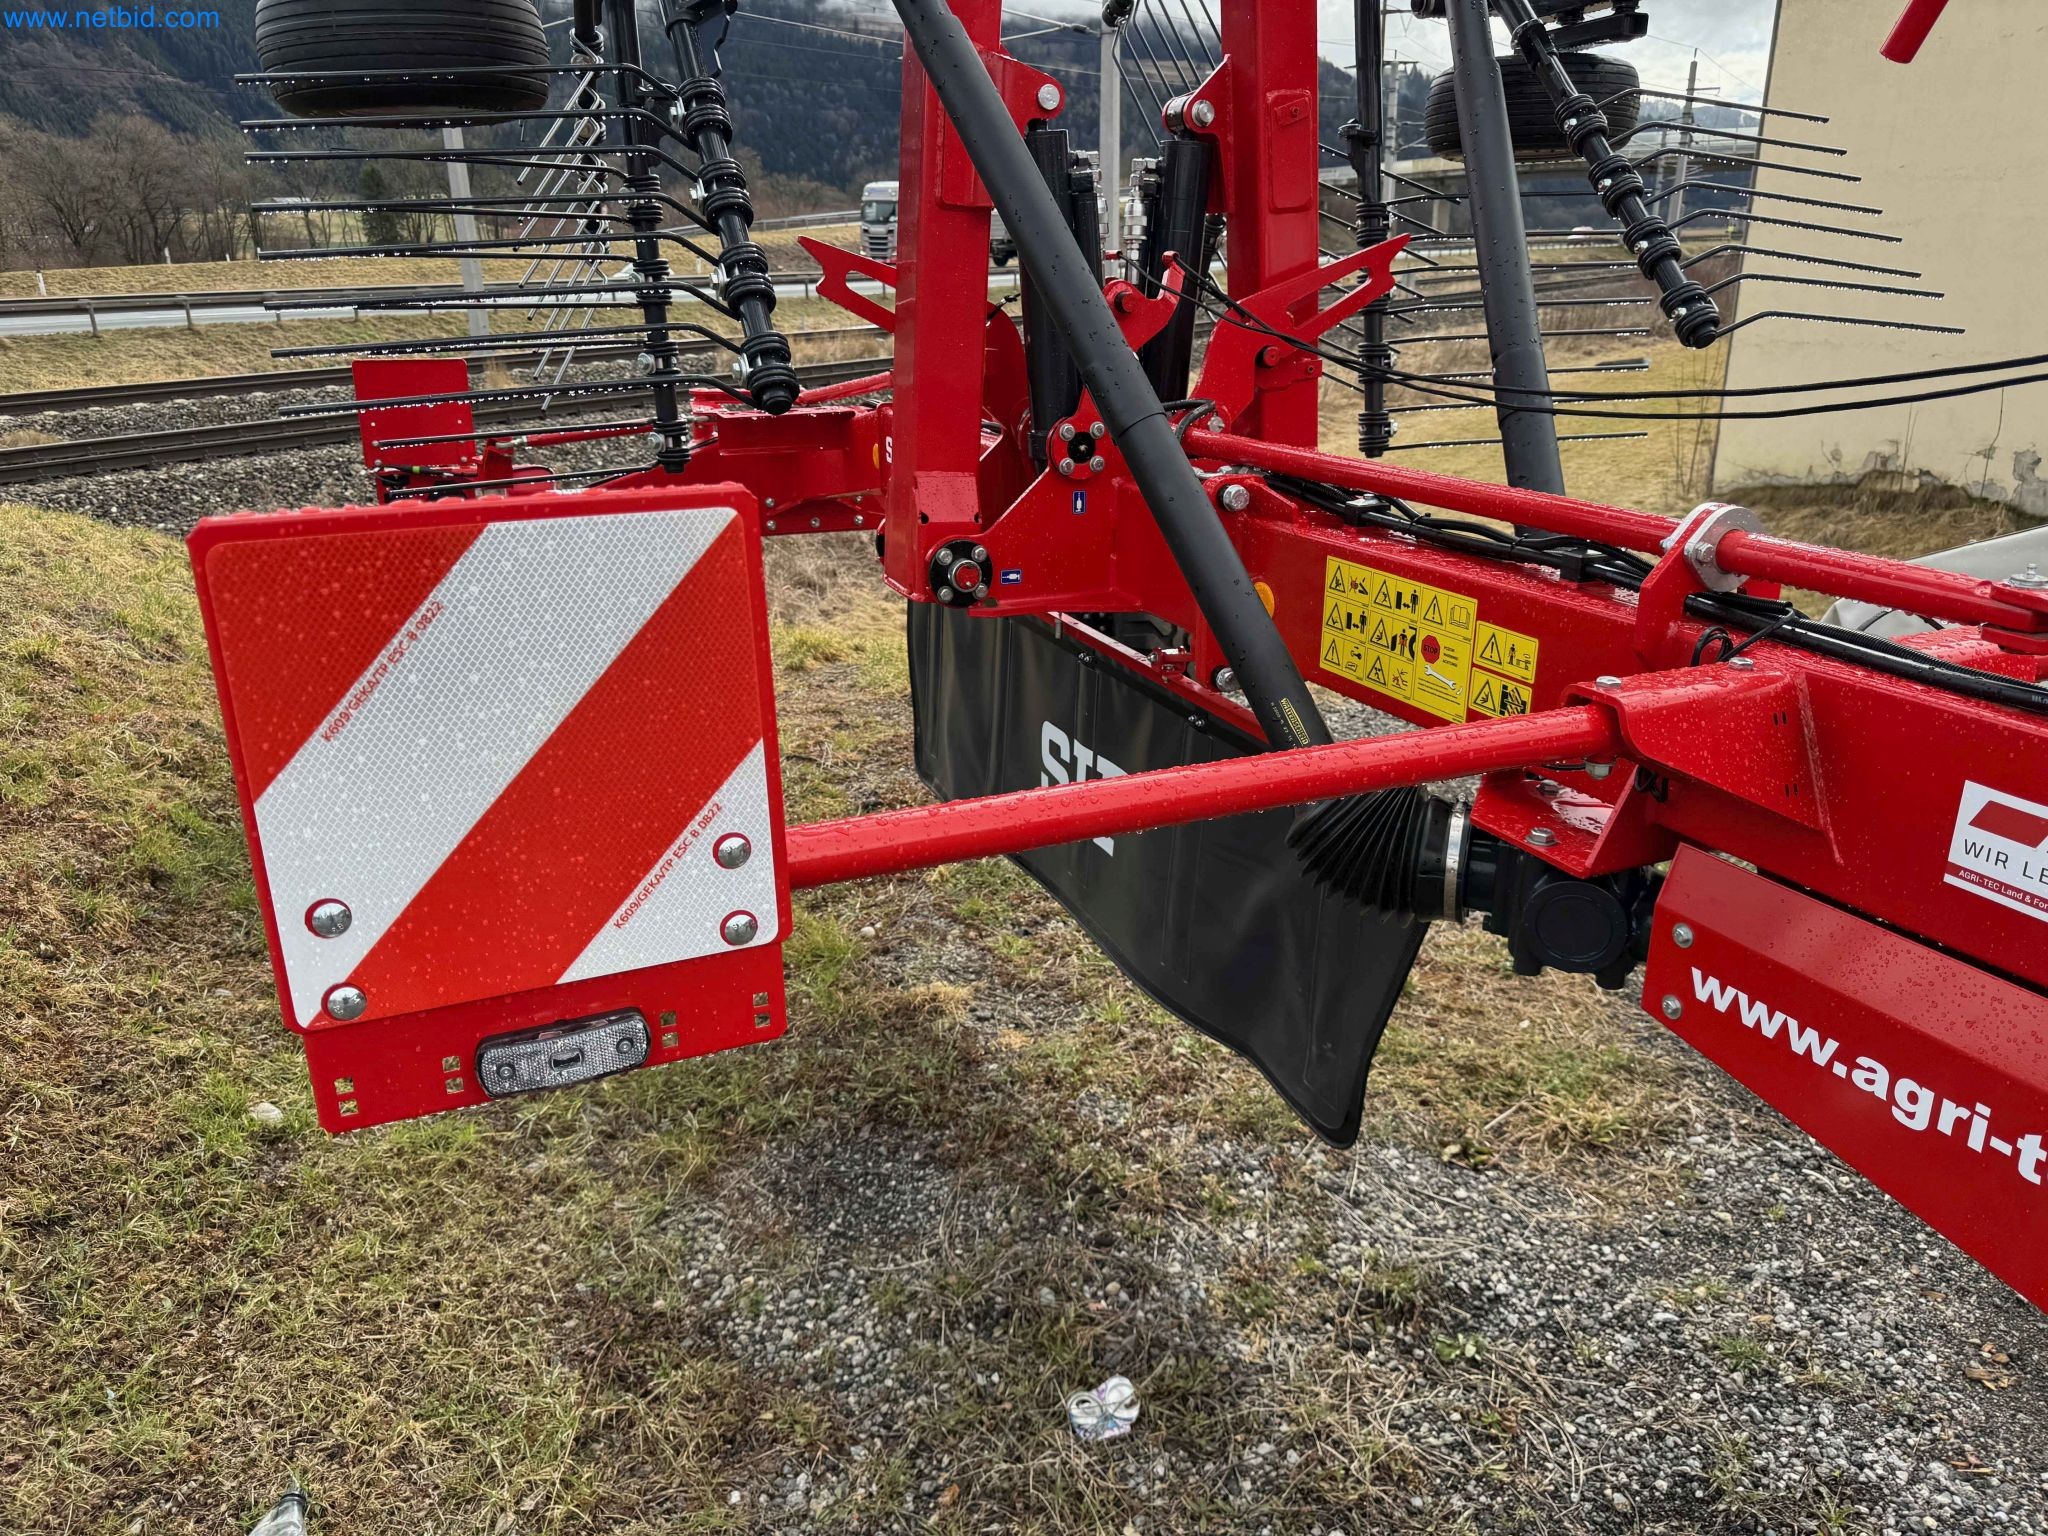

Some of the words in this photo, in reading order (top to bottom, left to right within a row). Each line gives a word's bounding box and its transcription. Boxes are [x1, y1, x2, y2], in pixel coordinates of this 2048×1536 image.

[387, 640, 411, 666] ESC
[415, 601, 444, 631] 0822
[1423, 644, 1439, 655] STOP
[614, 858, 674, 929] K609/GEKA/TP
[673, 838, 694, 859] ESC
[697, 803, 723, 829] 0822
[1964, 838, 2009, 870] WIR
[1958, 869, 2000, 891] AGRI-TEC
[2001, 885, 2024, 900] Land
[2024, 895, 2032, 903] &
